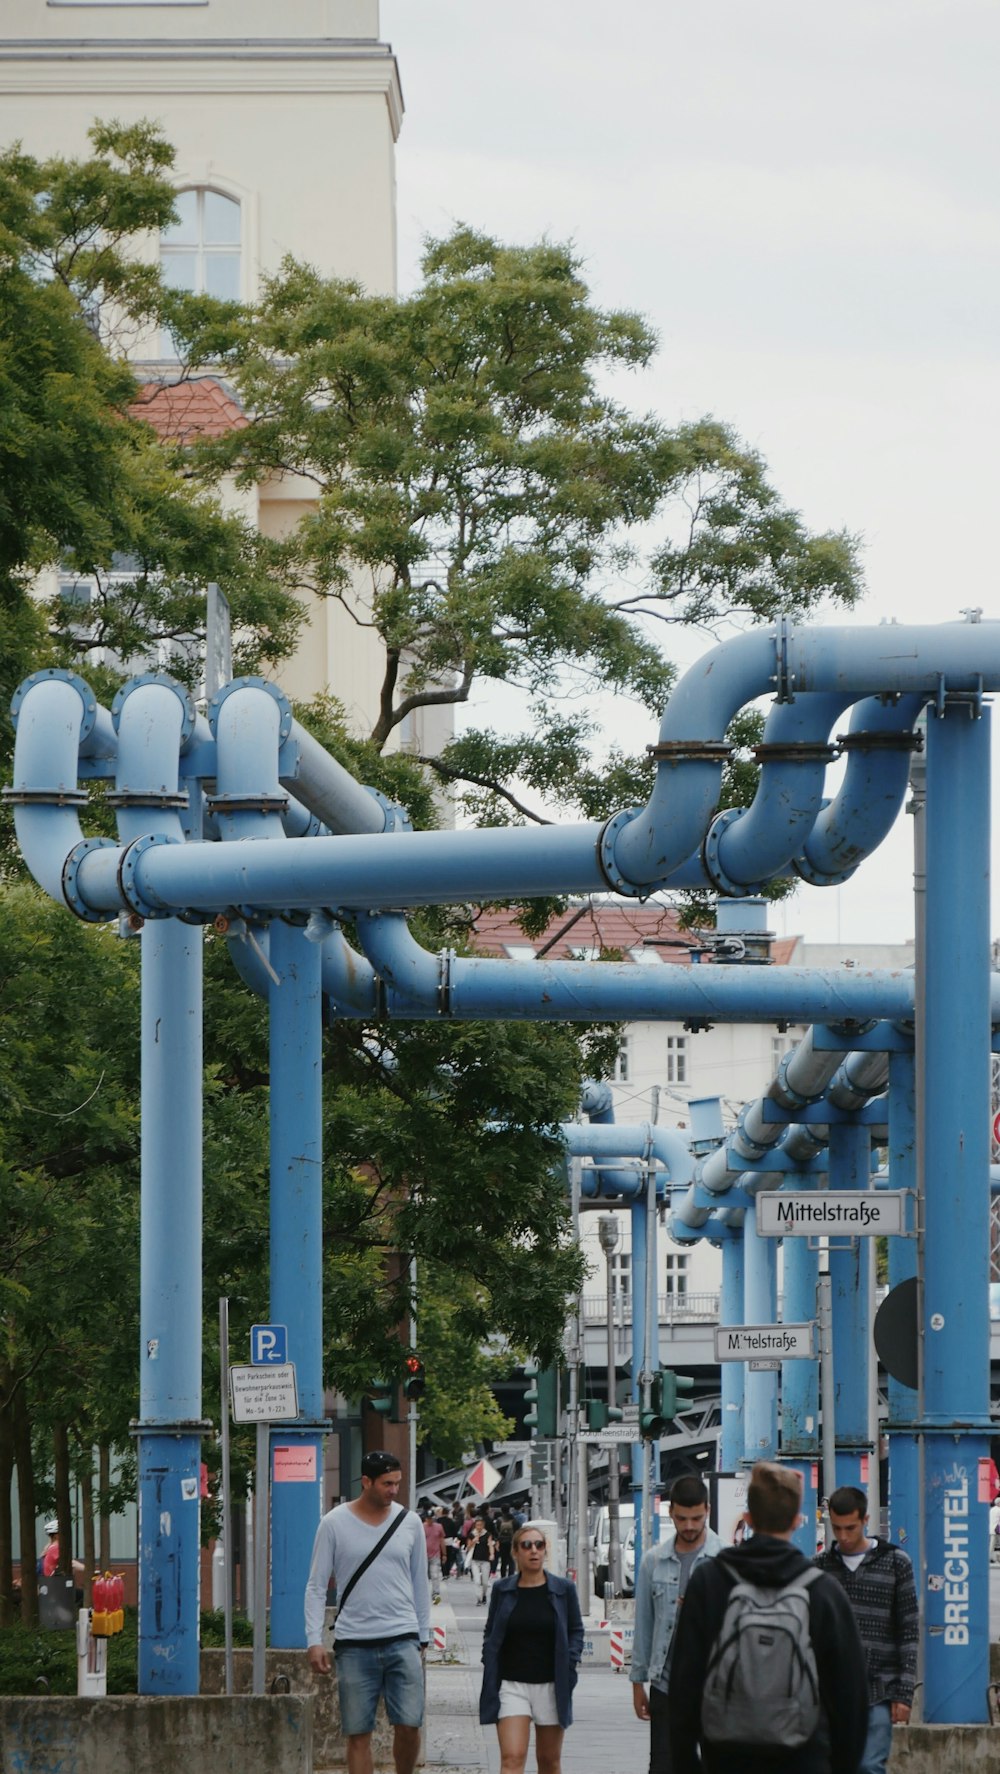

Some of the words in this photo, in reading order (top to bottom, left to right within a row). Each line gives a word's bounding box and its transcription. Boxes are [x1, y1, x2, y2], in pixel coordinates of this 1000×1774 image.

[777, 1201, 880, 1226] Mittelstraße
[257, 1331, 276, 1360] P
[277, 1371, 289, 1379] oder
[265, 1394, 277, 1402] Zone
[944, 1478, 969, 1645] BRECHTEL
